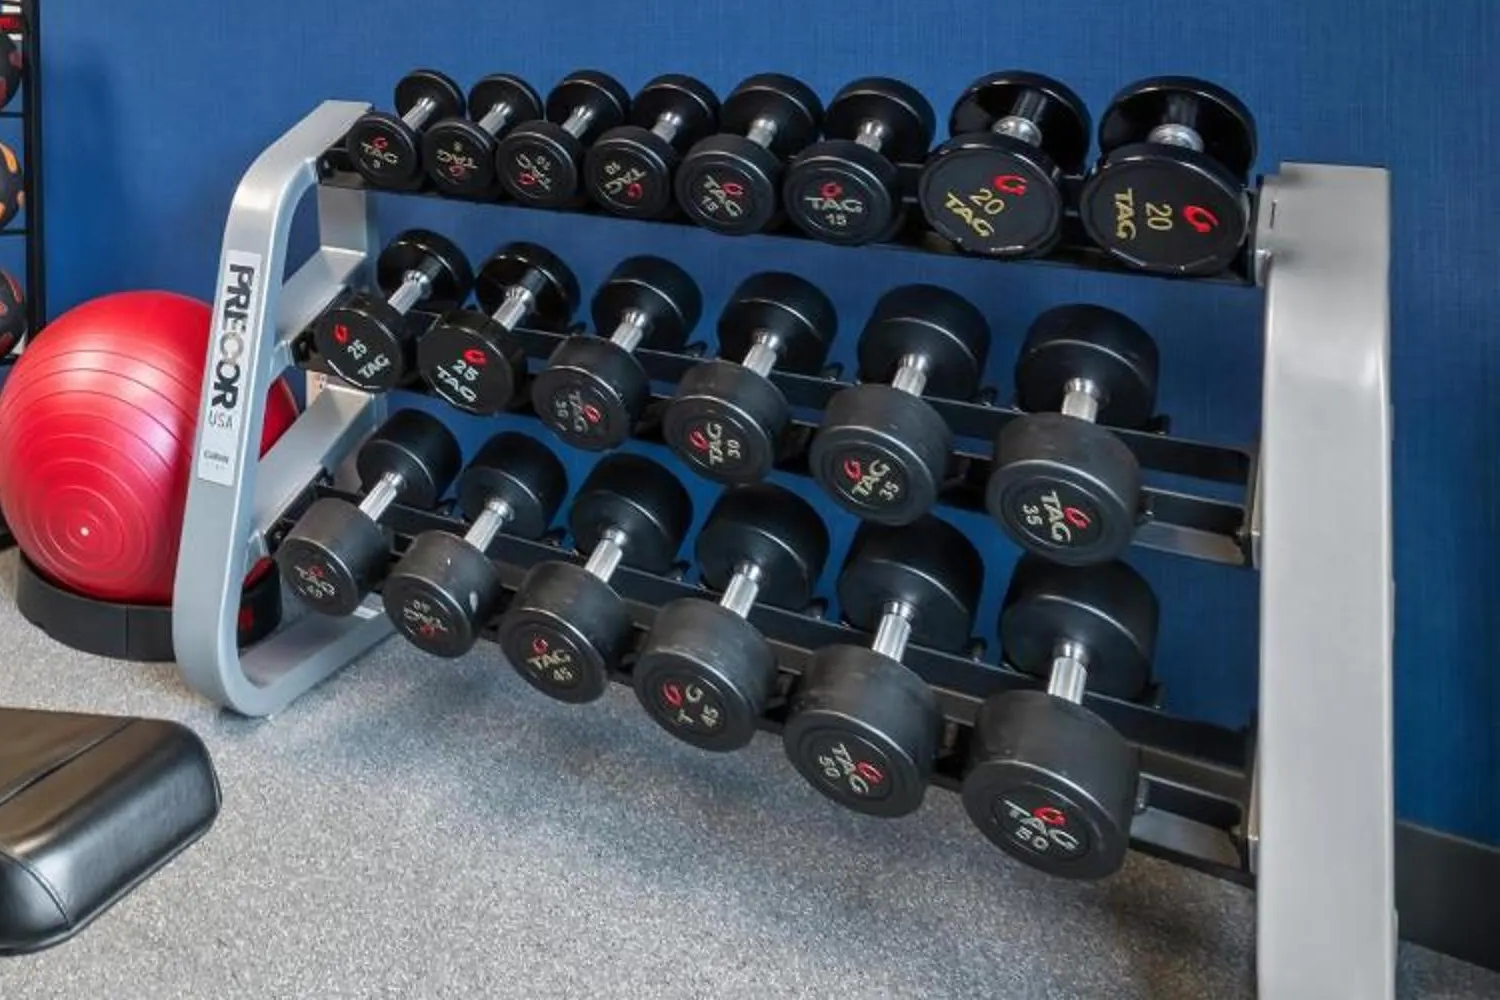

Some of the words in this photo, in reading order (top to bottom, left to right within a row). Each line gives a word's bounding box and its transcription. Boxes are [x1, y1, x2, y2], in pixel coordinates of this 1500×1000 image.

[703, 175, 743, 217] TAG
[804, 197, 863, 213] TAG
[969, 187, 1005, 215] 20
[825, 213, 847, 226] 15
[946, 191, 995, 237] TAG
[1114, 188, 1137, 241] TAG
[1145, 202, 1173, 232] 20
[211, 263, 255, 410] PRECOR
[347, 339, 368, 361] 25
[357, 354, 392, 380] TAG
[452, 359, 479, 381] 25
[437, 364, 477, 403] TAG
[208, 411, 233, 430] USA
[706, 422, 723, 466] TAG
[852, 459, 891, 498] TAG
[878, 483, 899, 501] 35
[1023, 503, 1043, 527] 35
[1041, 490, 1072, 544] TAG
[525, 648, 572, 671] TAG
[677, 683, 704, 725] TG
[832, 743, 870, 795] TAG
[1003, 799, 1079, 850] TAG
[1015, 825, 1050, 850] 50
